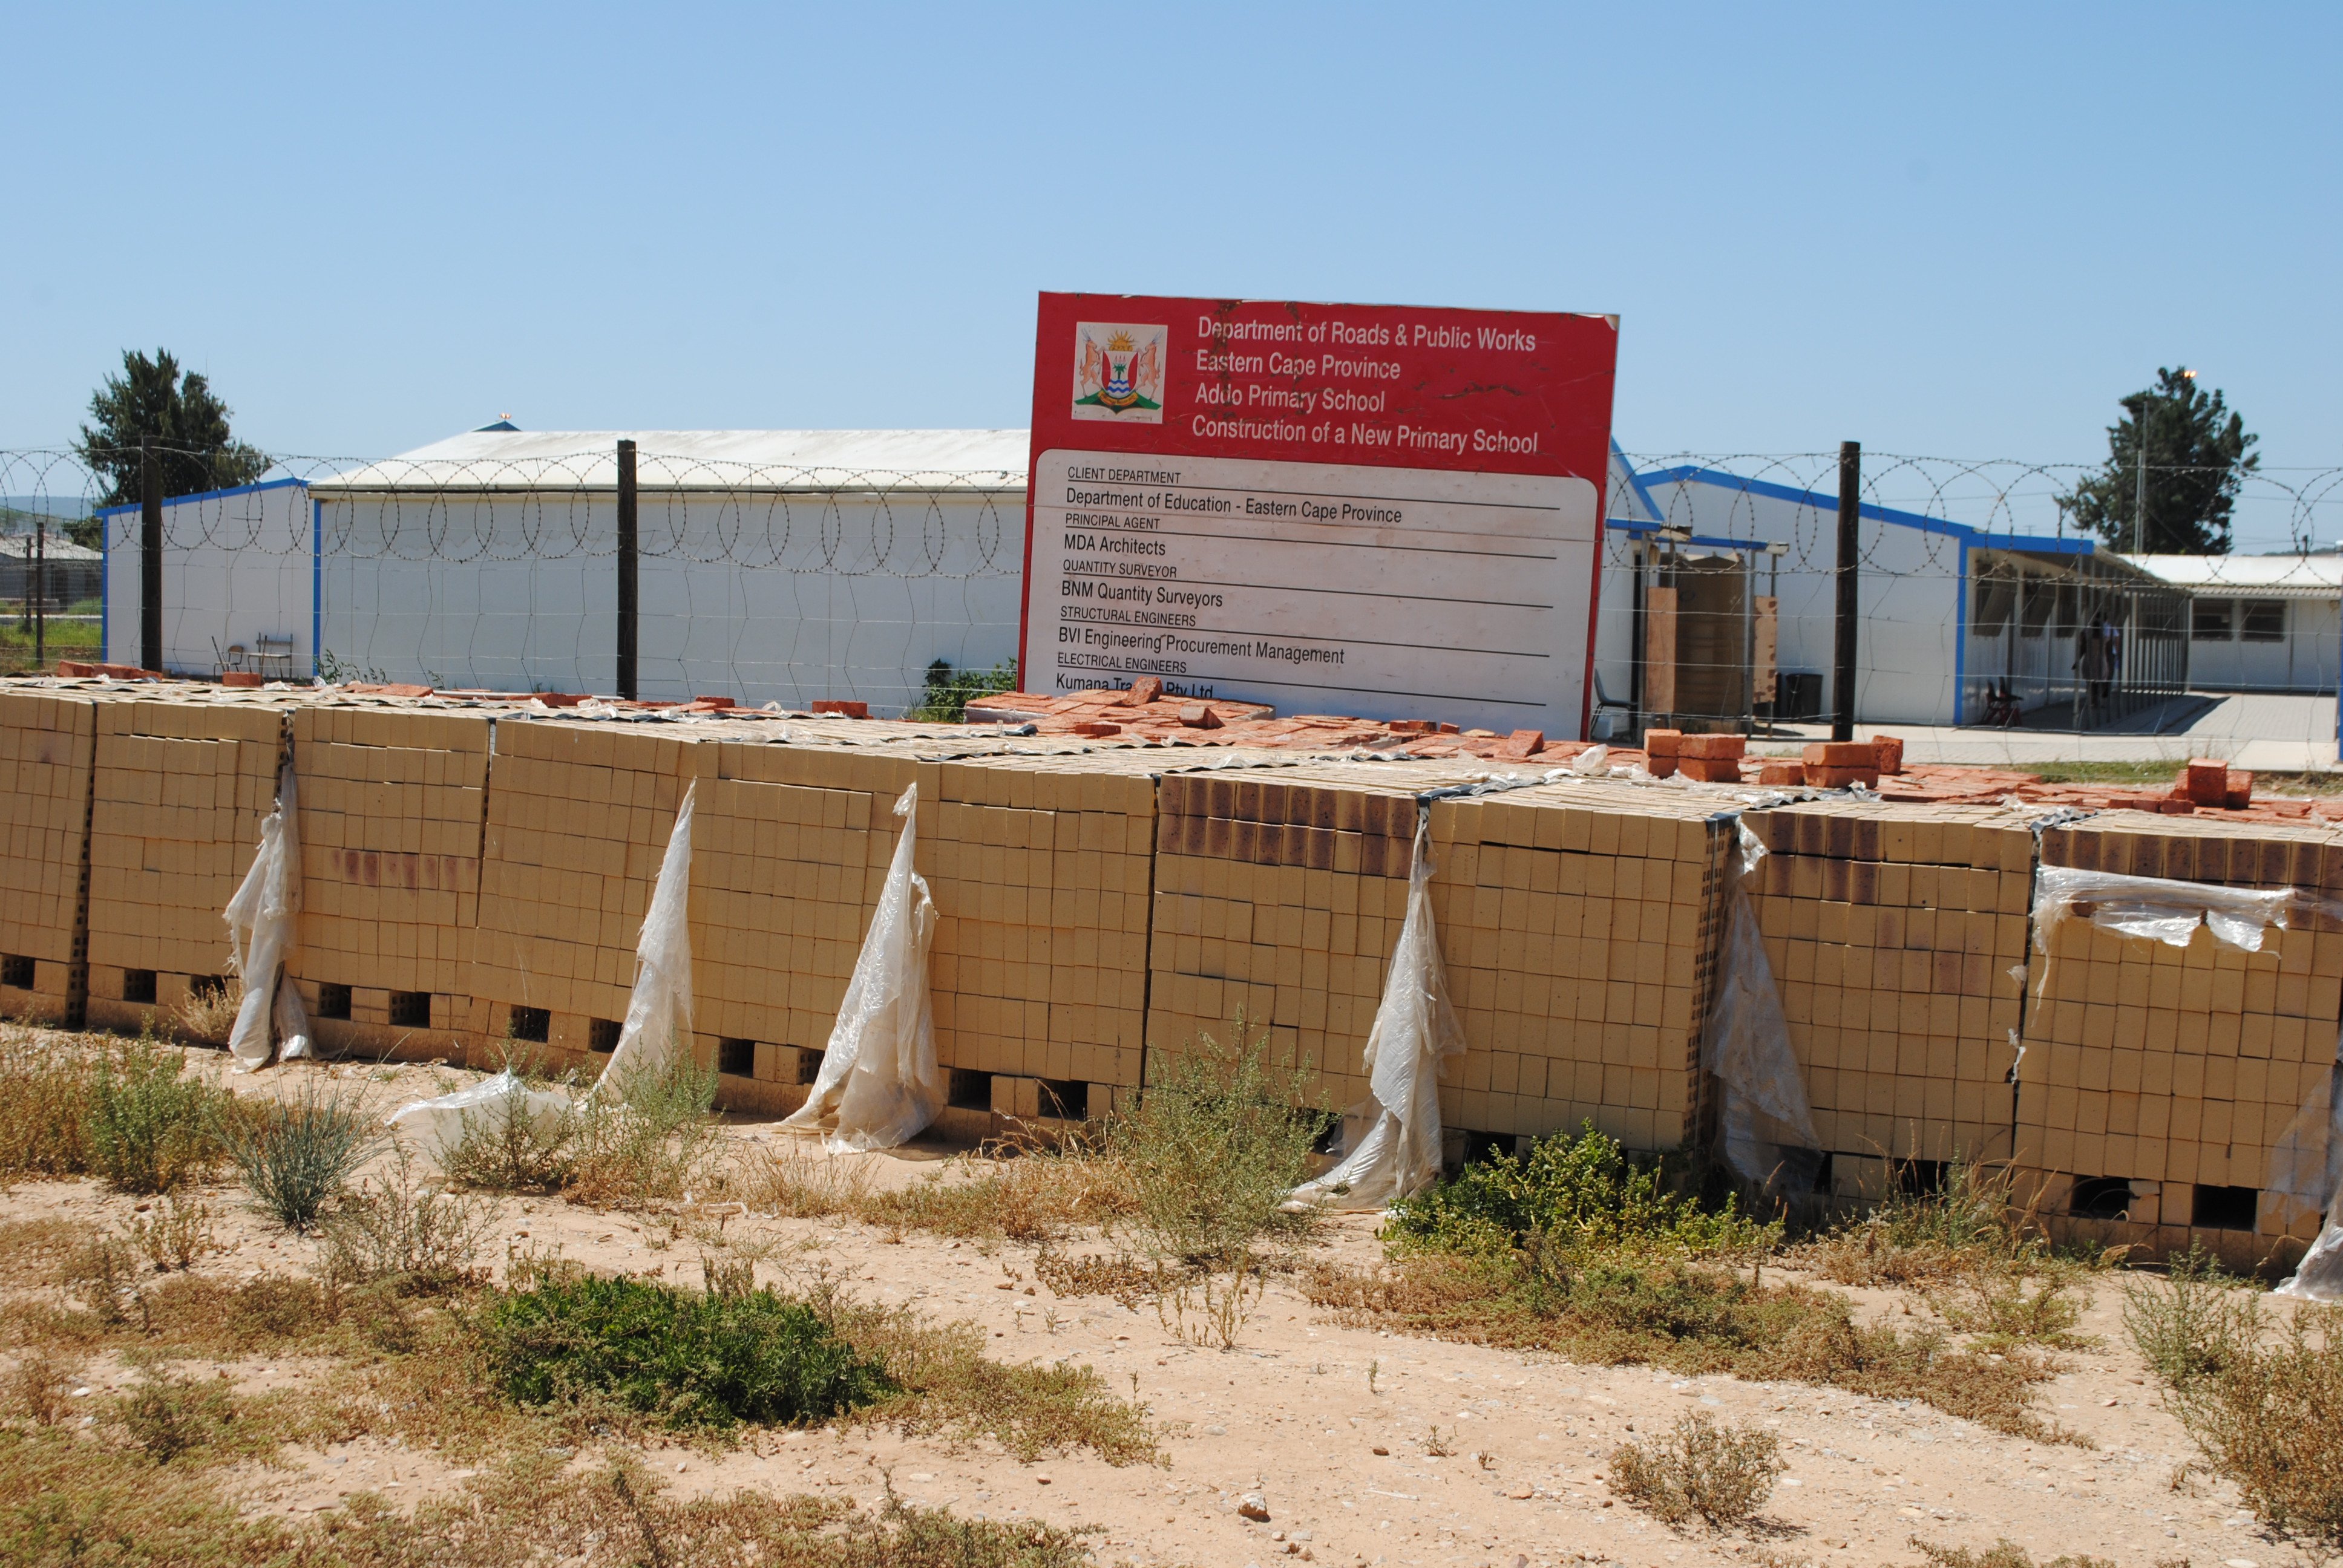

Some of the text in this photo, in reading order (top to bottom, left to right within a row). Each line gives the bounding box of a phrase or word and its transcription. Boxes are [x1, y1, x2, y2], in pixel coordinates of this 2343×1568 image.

[1198, 316, 1536, 351] Department of Roads & Public Works
[1196, 349, 1401, 379] Eastern Cape Province
[1195, 382, 1384, 414] Addo Primary School
[1193, 415, 1538, 455] Construction of a New Primary School
[1068, 466, 1181, 484] CLIENT DEPARTMENT
[1067, 488, 1142, 507] Department
[1148, 493, 1161, 508] of
[1165, 493, 1231, 512] Education
[1246, 498, 1297, 516] Eastern
[1302, 501, 1337, 521] Cape
[1342, 504, 1401, 523] Province
[1066, 513, 1160, 529] PRINCIPAL AGENT
[1064, 534, 1165, 555] MDA Architects
[1063, 559, 1177, 578] QUANTITY SURVEYOR
[1062, 580, 1223, 609] BNM Quantity Surveyors
[1061, 606, 1196, 627] STRUCTURAL ENGINEERS
[1059, 627, 1345, 664] BVI Engineering Procurement Management
[1058, 652, 1187, 673] ELECTRICAL ENGINEERS
[1056, 673, 1109, 690] Kumana
